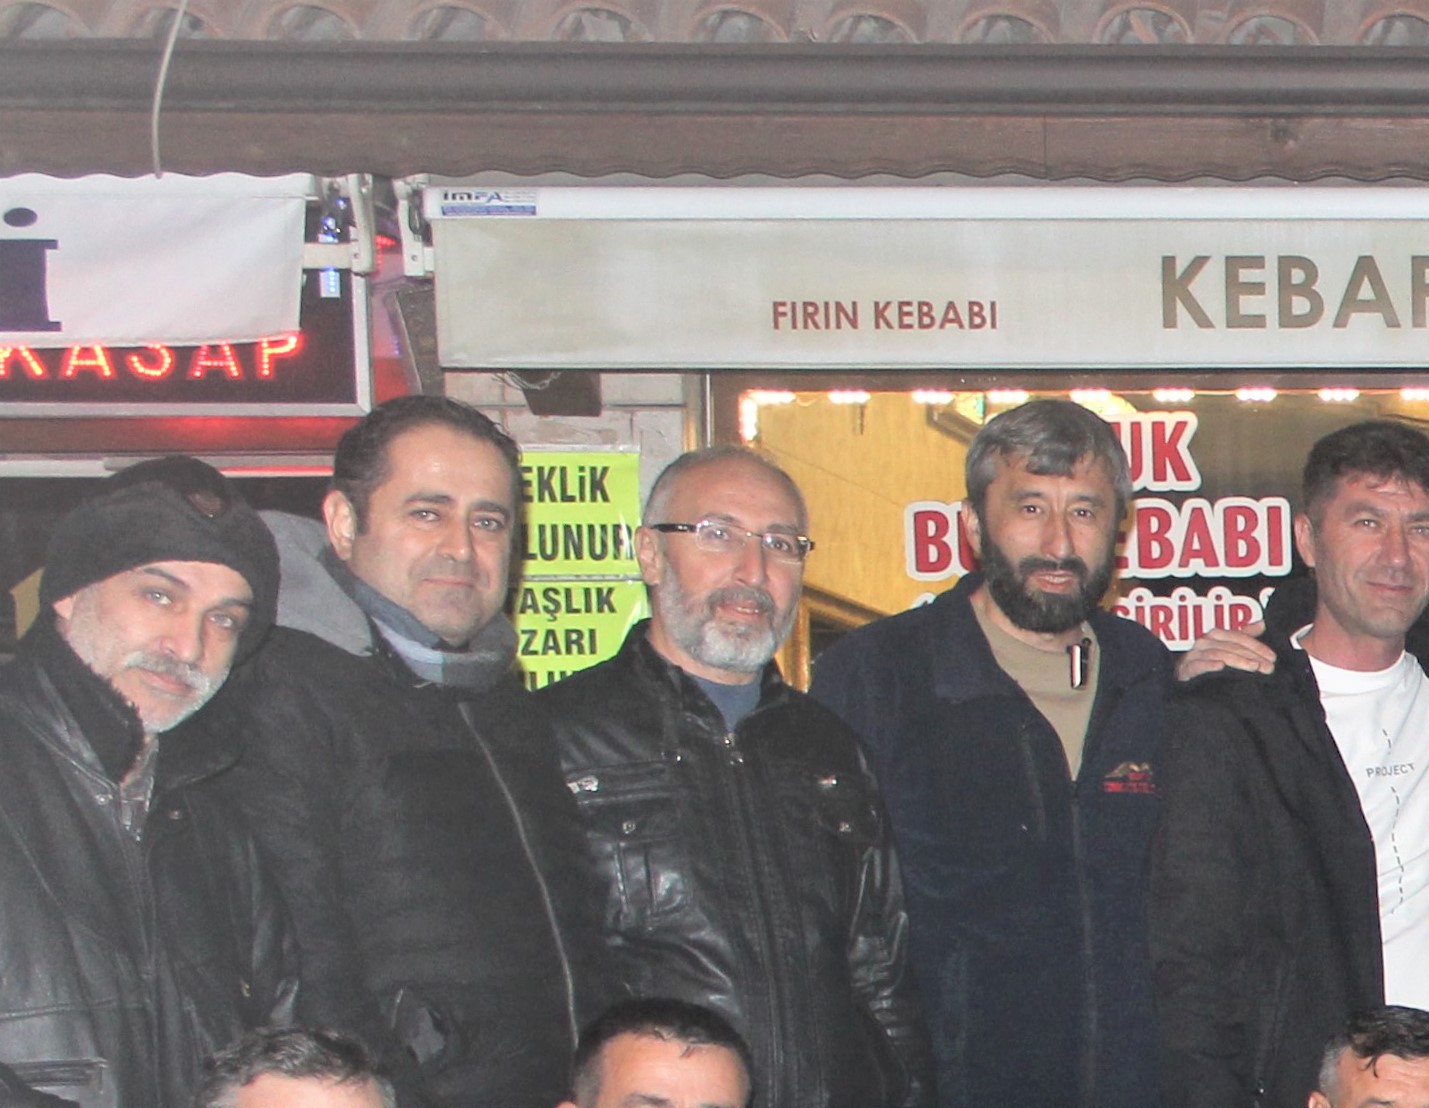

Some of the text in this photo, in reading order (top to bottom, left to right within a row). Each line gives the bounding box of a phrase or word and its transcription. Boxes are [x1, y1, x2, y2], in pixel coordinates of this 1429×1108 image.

[772, 300, 998, 330] FIRIN KEBABI
[520, 628, 597, 656] ZARI
[1366, 762, 1415, 778] PROJECT
